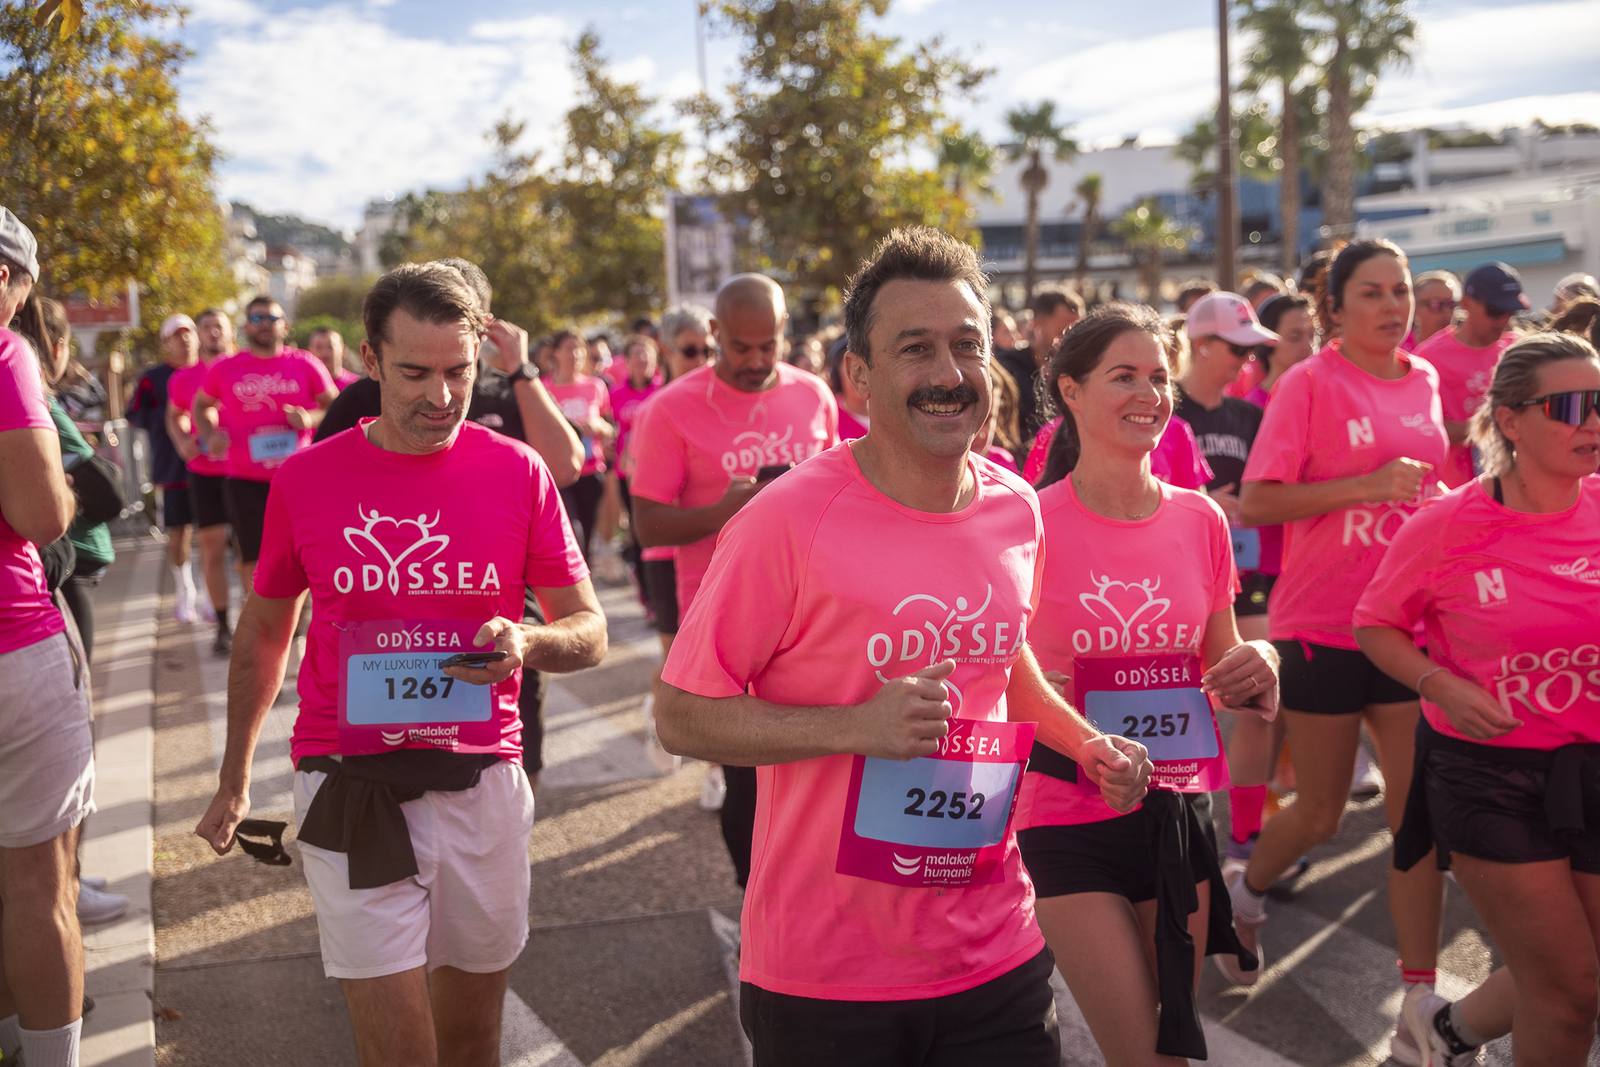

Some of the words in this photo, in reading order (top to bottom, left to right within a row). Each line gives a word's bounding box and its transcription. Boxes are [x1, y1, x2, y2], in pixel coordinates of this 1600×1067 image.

[333, 561, 501, 596] ODYSSEA
[376, 624, 461, 650] ODYSSEA
[867, 621, 1026, 667] ODYSSEA
[1072, 623, 1201, 654] ODYSSEA
[362, 661, 382, 671] MY
[384, 659, 430, 671] LUXURY
[1114, 660, 1191, 687] ODYSSEA
[385, 677, 455, 700] 1267
[408, 725, 460, 738] malakoff
[1122, 713, 1190, 738] 2257
[903, 787, 986, 820] 2252
[925, 852, 977, 866] malakoff
[923, 865, 973, 879] humanis
